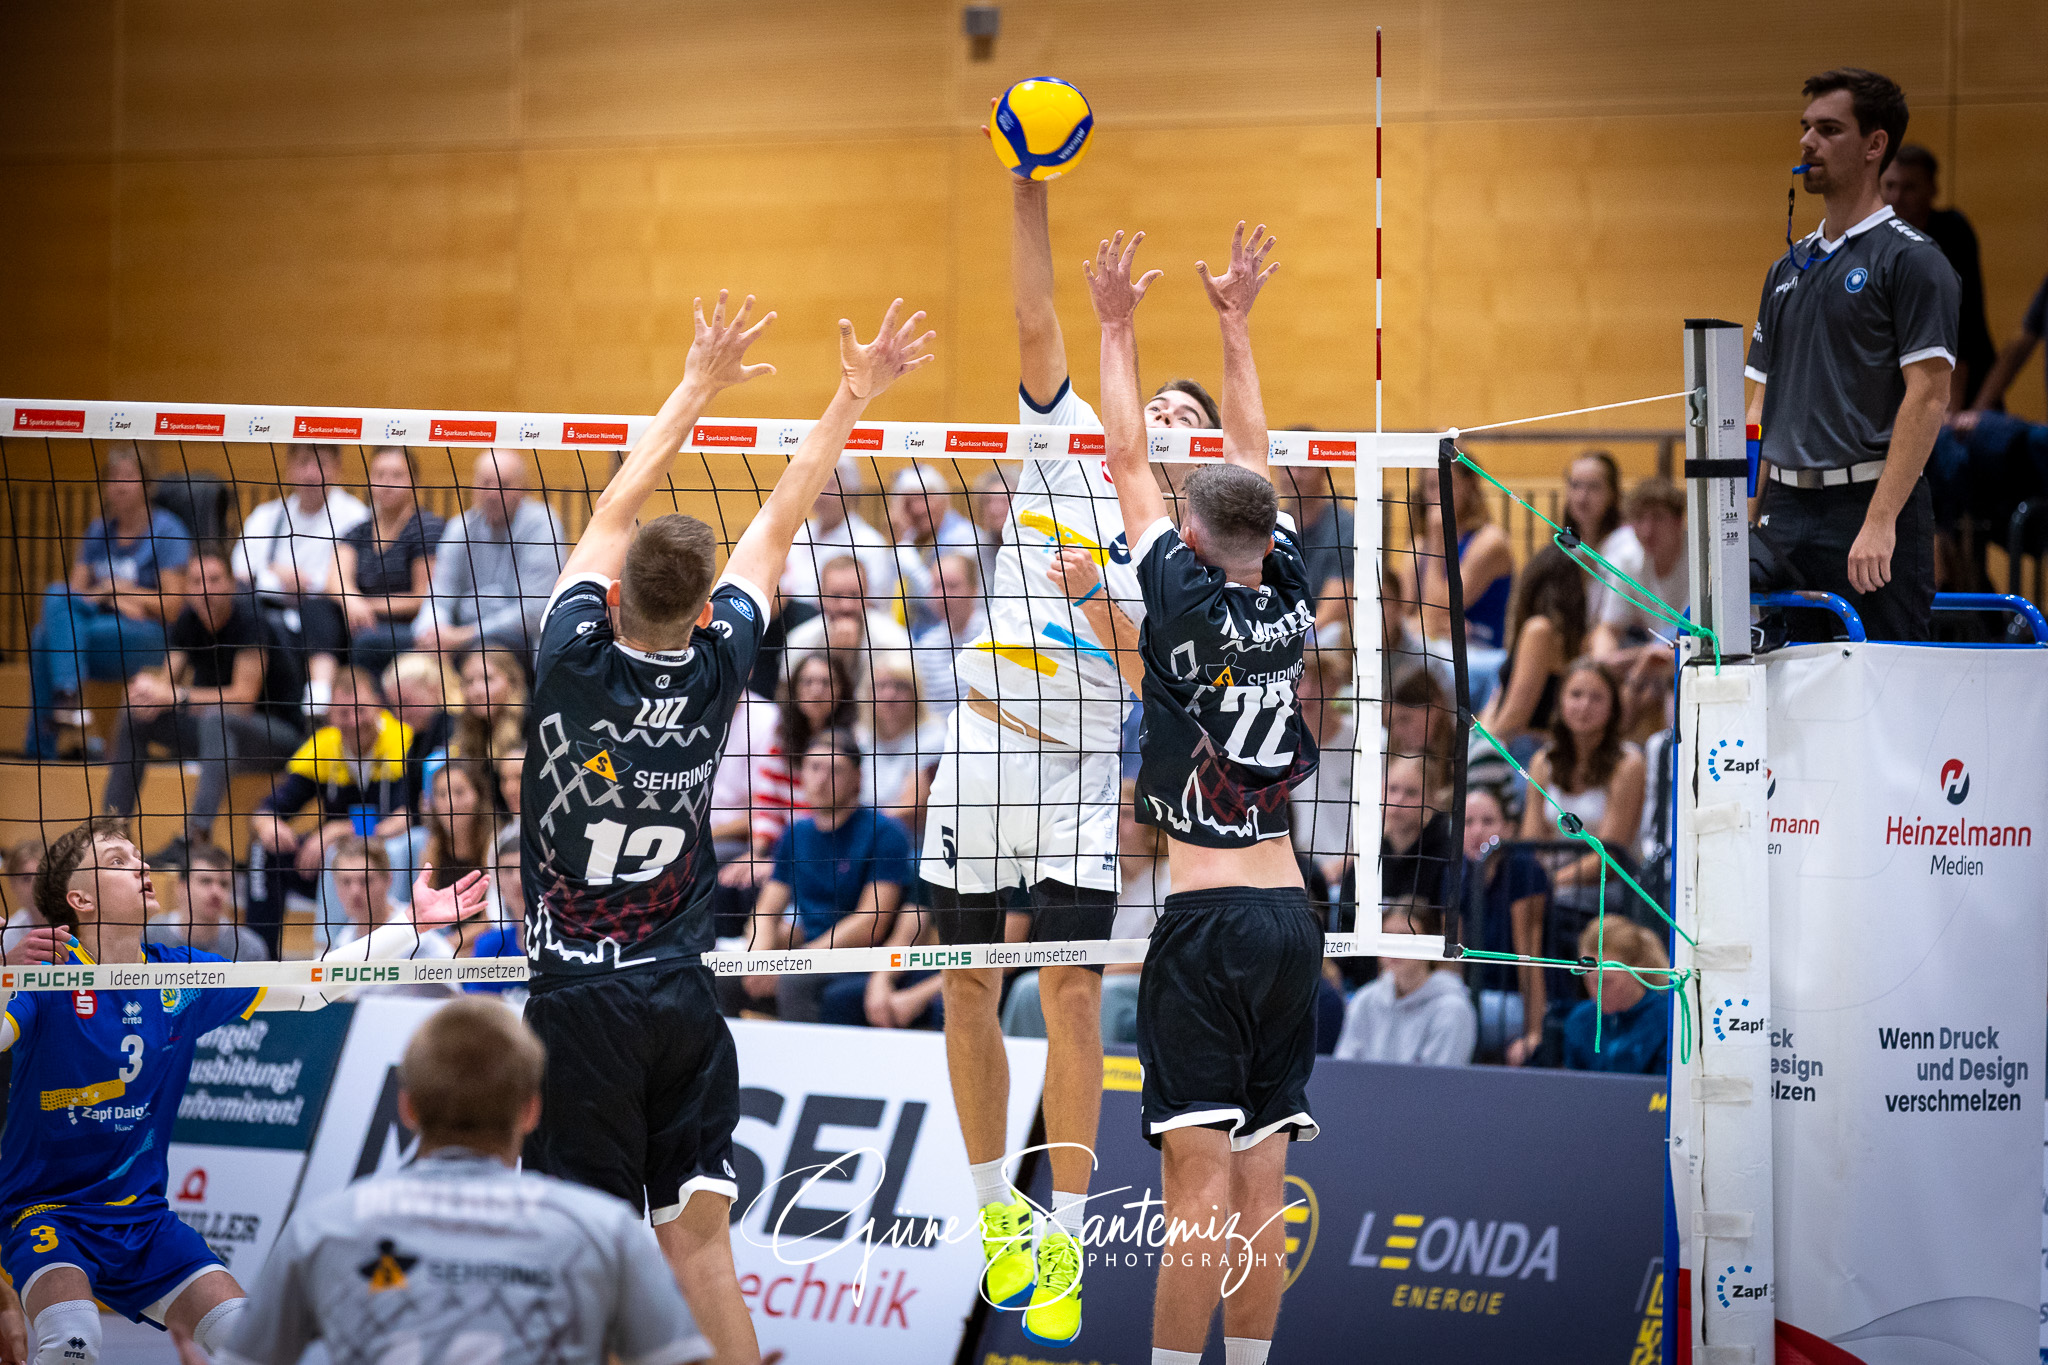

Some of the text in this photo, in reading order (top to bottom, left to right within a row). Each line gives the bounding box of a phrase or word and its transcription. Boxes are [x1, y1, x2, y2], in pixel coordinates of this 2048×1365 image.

[28, 419, 55, 427] Sparkasse
[115, 421, 131, 430] Zapf
[170, 423, 194, 431] Sparkasse
[254, 425, 270, 433] Zapf
[308, 426, 333, 434] Sparkasse
[391, 428, 407, 437] Zapf
[443, 429, 468, 437] Sparkasse
[525, 431, 540, 439] Zapf
[576, 432, 600, 440] Sparkasse
[784, 436, 799, 445] Zapf
[910, 439, 925, 447] Zapf
[1034, 442, 1048, 450] Zapf
[1155, 444, 1170, 453] Zapf
[1274, 448, 1288, 456] Zapf
[633, 696, 689, 729] LUZ
[1724, 758, 1761, 774] Zapf
[633, 759, 713, 790] SEHRING
[1886, 816, 2031, 847] Heinzelmann
[1930, 855, 1984, 876] Medien
[747, 957, 812, 972] umsetzen
[909, 949, 1087, 967] FUCHS Ideen umsetzen
[23, 970, 226, 987] FUCHS Ideen umsetzen
[331, 964, 525, 982] FUCHS Ideen umsetzen
[1729, 1018, 1765, 1034] Zapf
[1879, 1026, 1999, 1050] Wenn Druck
[119, 1034, 144, 1083] 3
[1771, 1053, 1823, 1082] esign
[1917, 1055, 2028, 1088] und Design
[1885, 1089, 2021, 1112] verschmelzen
[82, 1106, 112, 1123] Zapf
[30, 1225, 59, 1253] 3
[1349, 1211, 1560, 1282] LEONDA
[737, 1261, 919, 1330] echnik
[1391, 1284, 1505, 1315] ENERGIE
[1732, 1283, 1768, 1300] Zapf
[64, 1351, 85, 1360] errea
